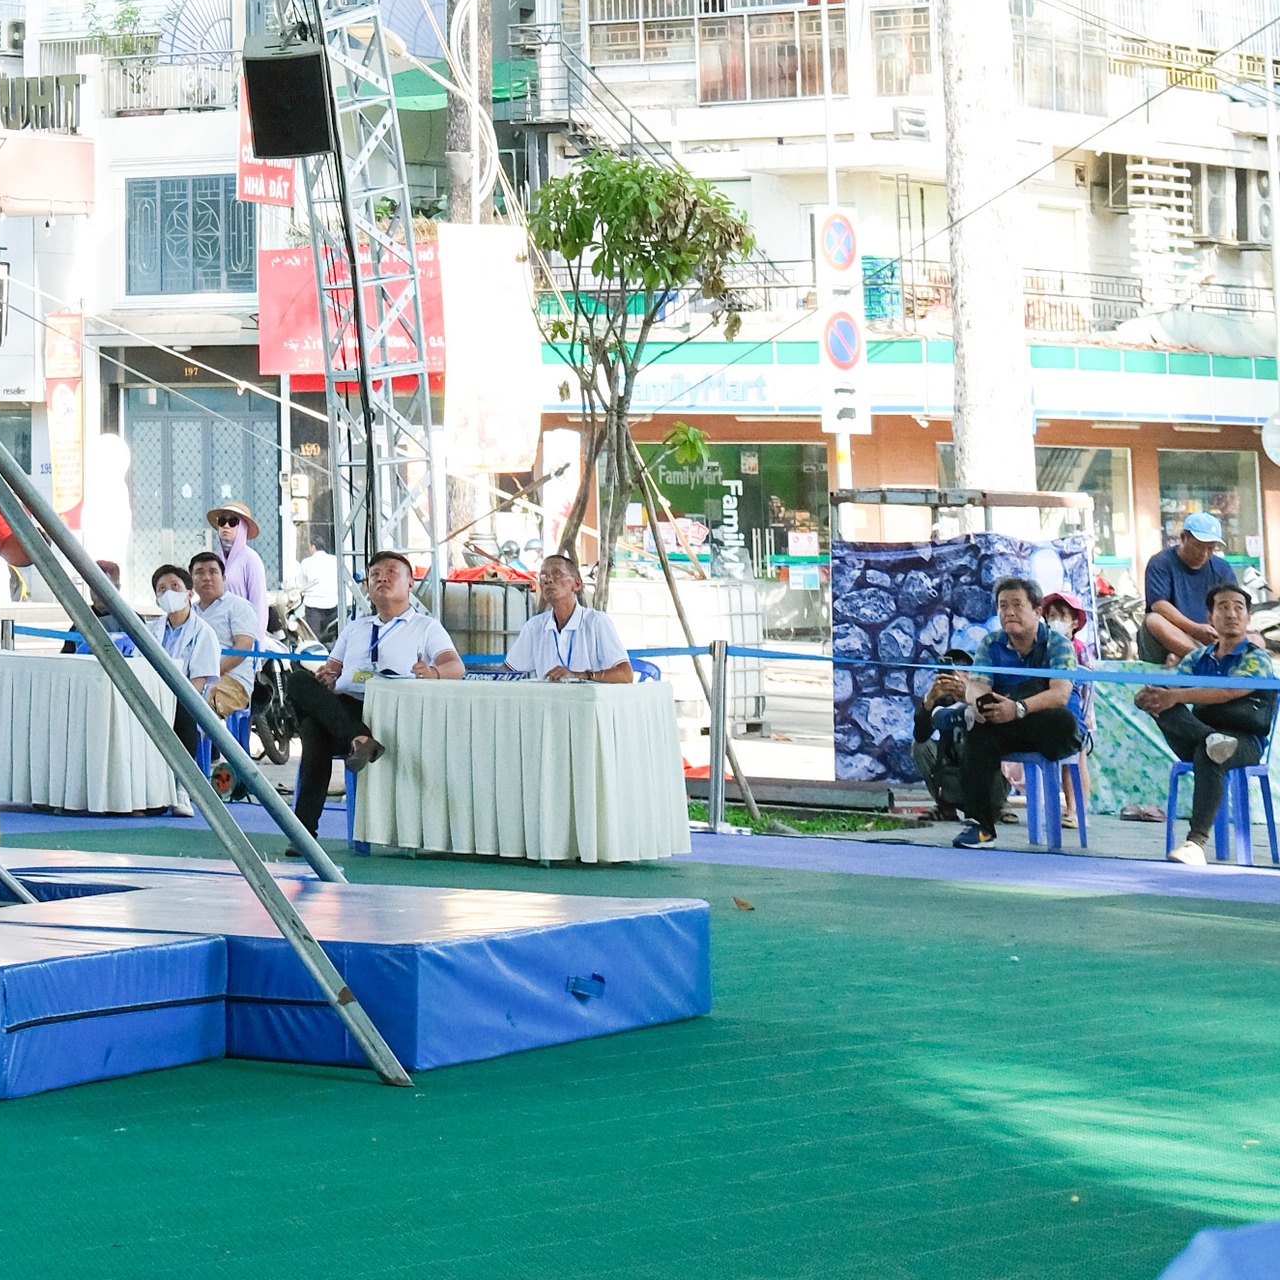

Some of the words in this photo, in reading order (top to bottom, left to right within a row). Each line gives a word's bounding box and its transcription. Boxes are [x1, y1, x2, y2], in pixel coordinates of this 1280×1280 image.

[243, 173, 266, 198] NHÀ
[268, 175, 290, 200] ĐẤT
[183, 367, 199, 377] 197
